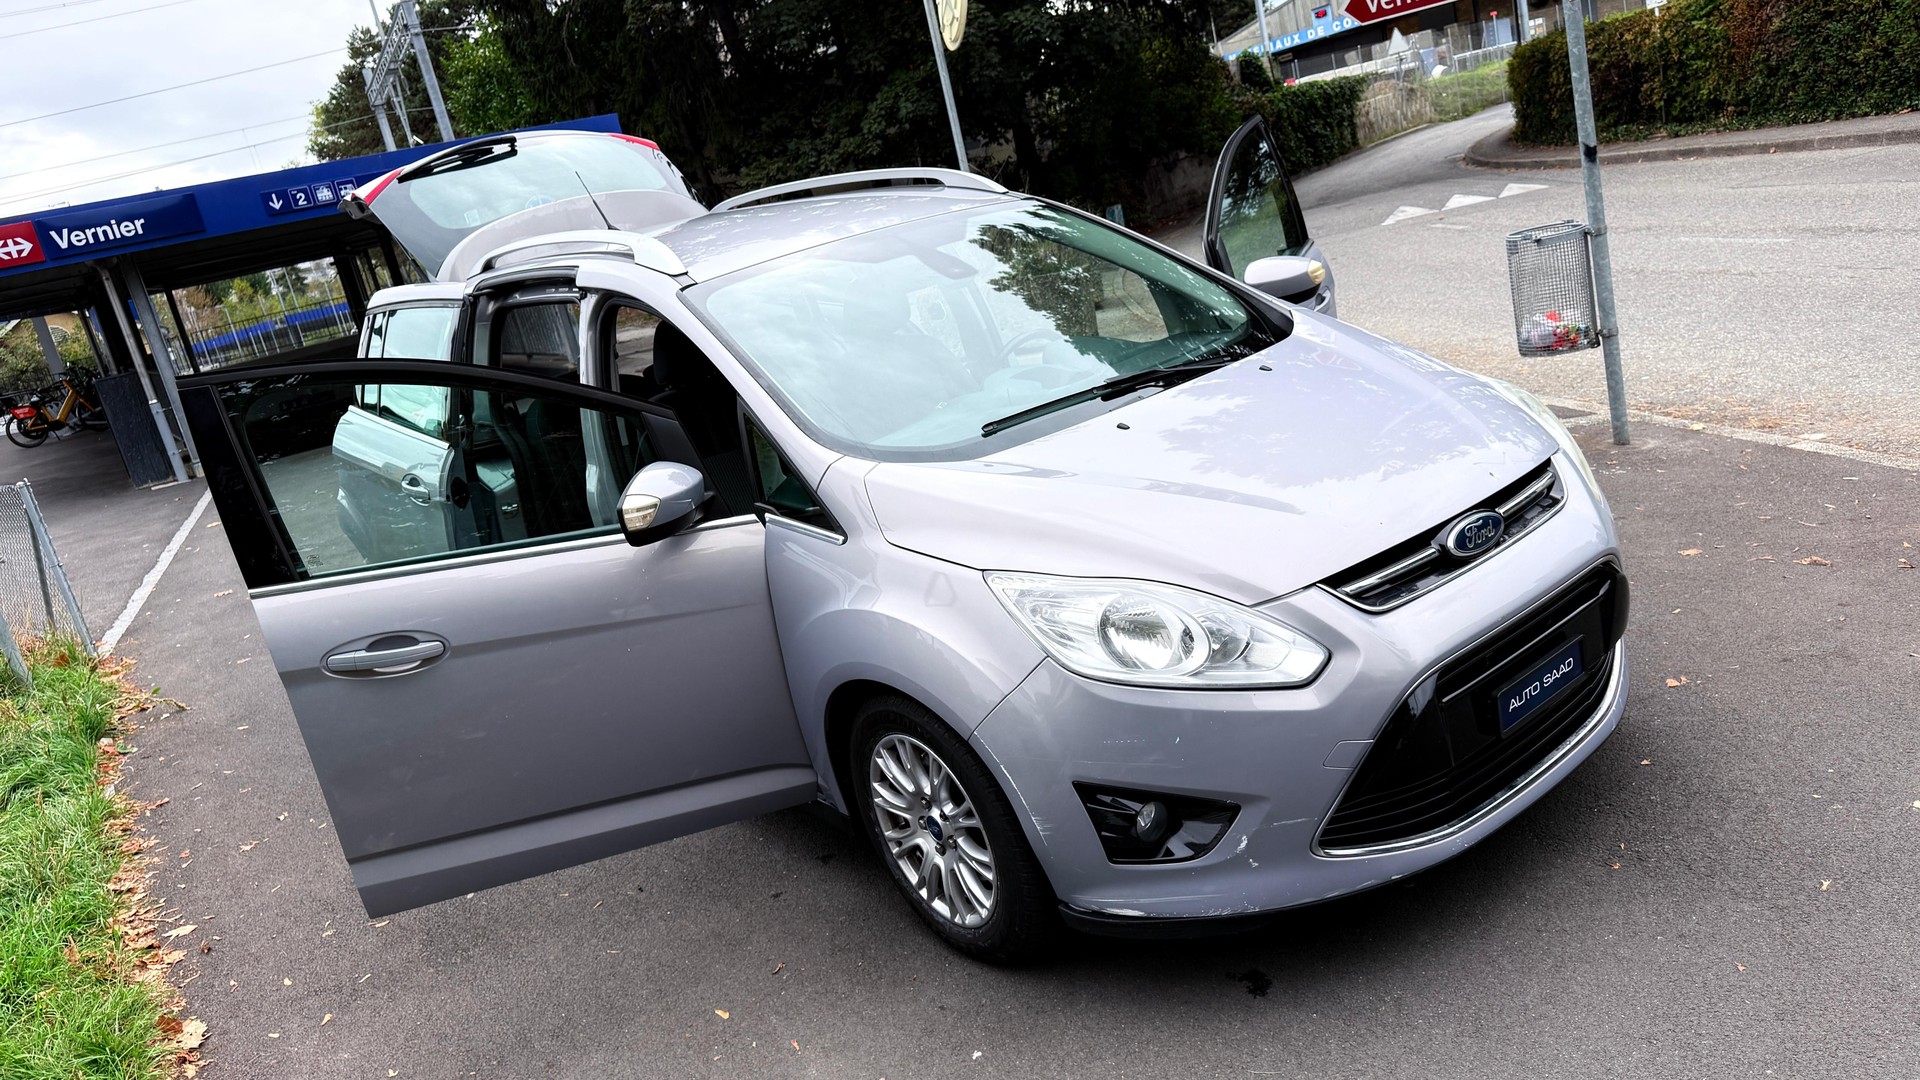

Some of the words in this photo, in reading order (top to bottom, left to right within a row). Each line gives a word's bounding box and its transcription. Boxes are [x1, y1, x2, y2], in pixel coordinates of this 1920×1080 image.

[1307, 26, 1325, 39] DE
[1332, 18, 1358, 31] CO
[296, 192, 308, 206] 2
[49, 218, 145, 250] Vernier
[1464, 519, 1496, 548] Ford
[1508, 681, 1541, 713] AUTO
[1543, 657, 1574, 687] SAAD
